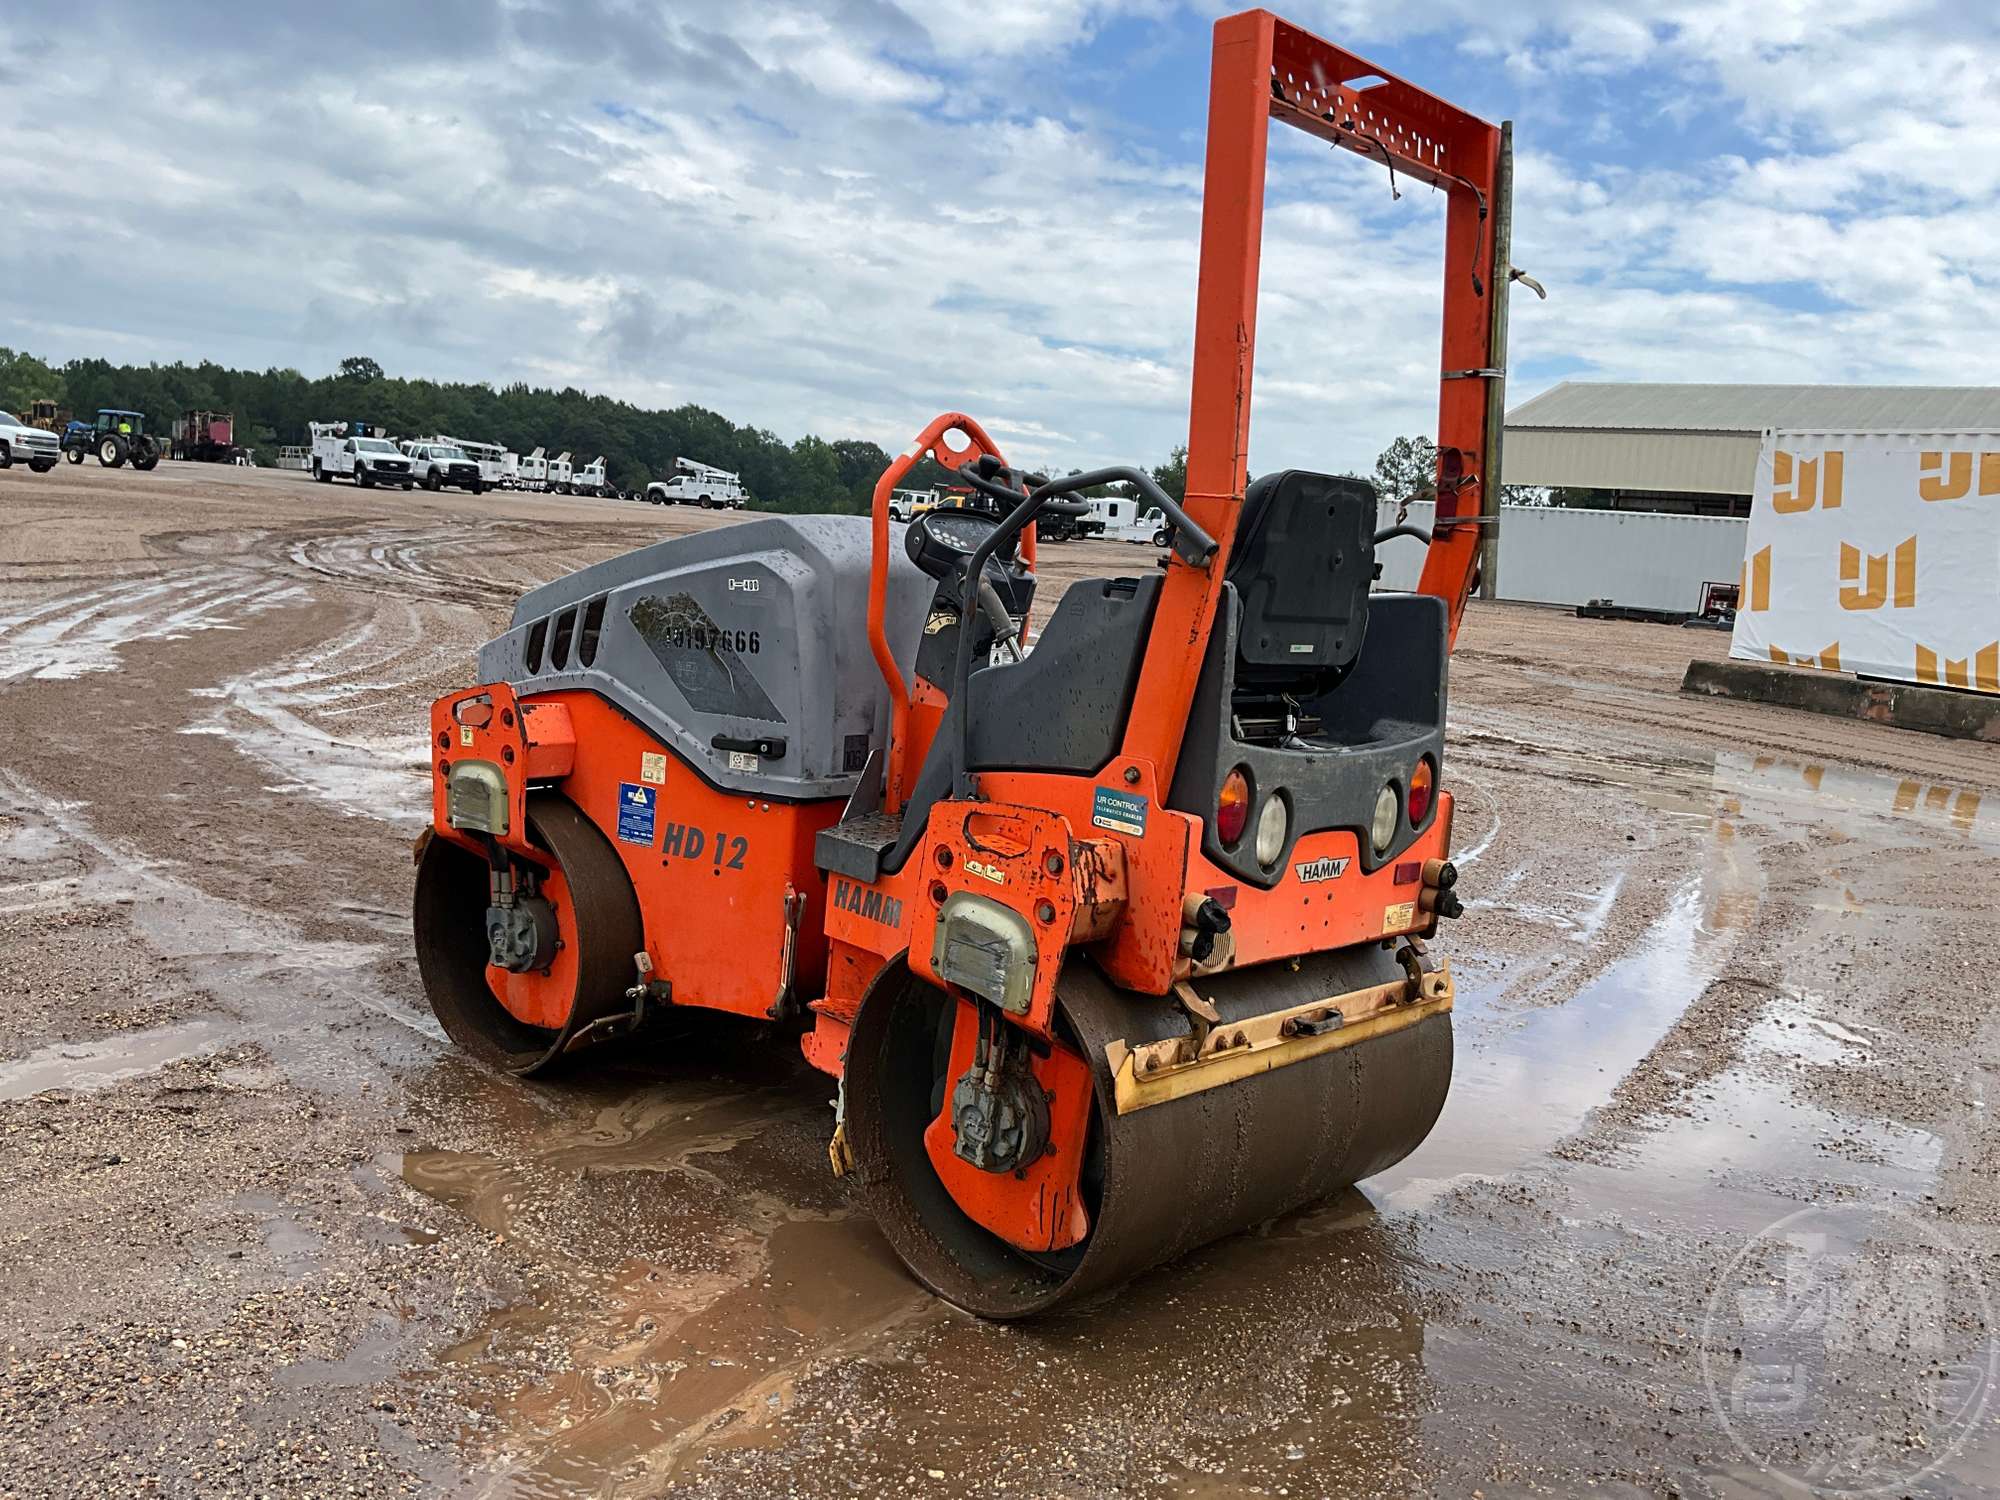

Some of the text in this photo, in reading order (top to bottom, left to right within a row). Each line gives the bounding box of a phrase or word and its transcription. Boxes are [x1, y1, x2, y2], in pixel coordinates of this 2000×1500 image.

[1097, 795, 1139, 812] UR CONTROL
[662, 822, 749, 871] HD 12
[1303, 861, 1341, 880] HAMM
[833, 879, 904, 929] HAMM
